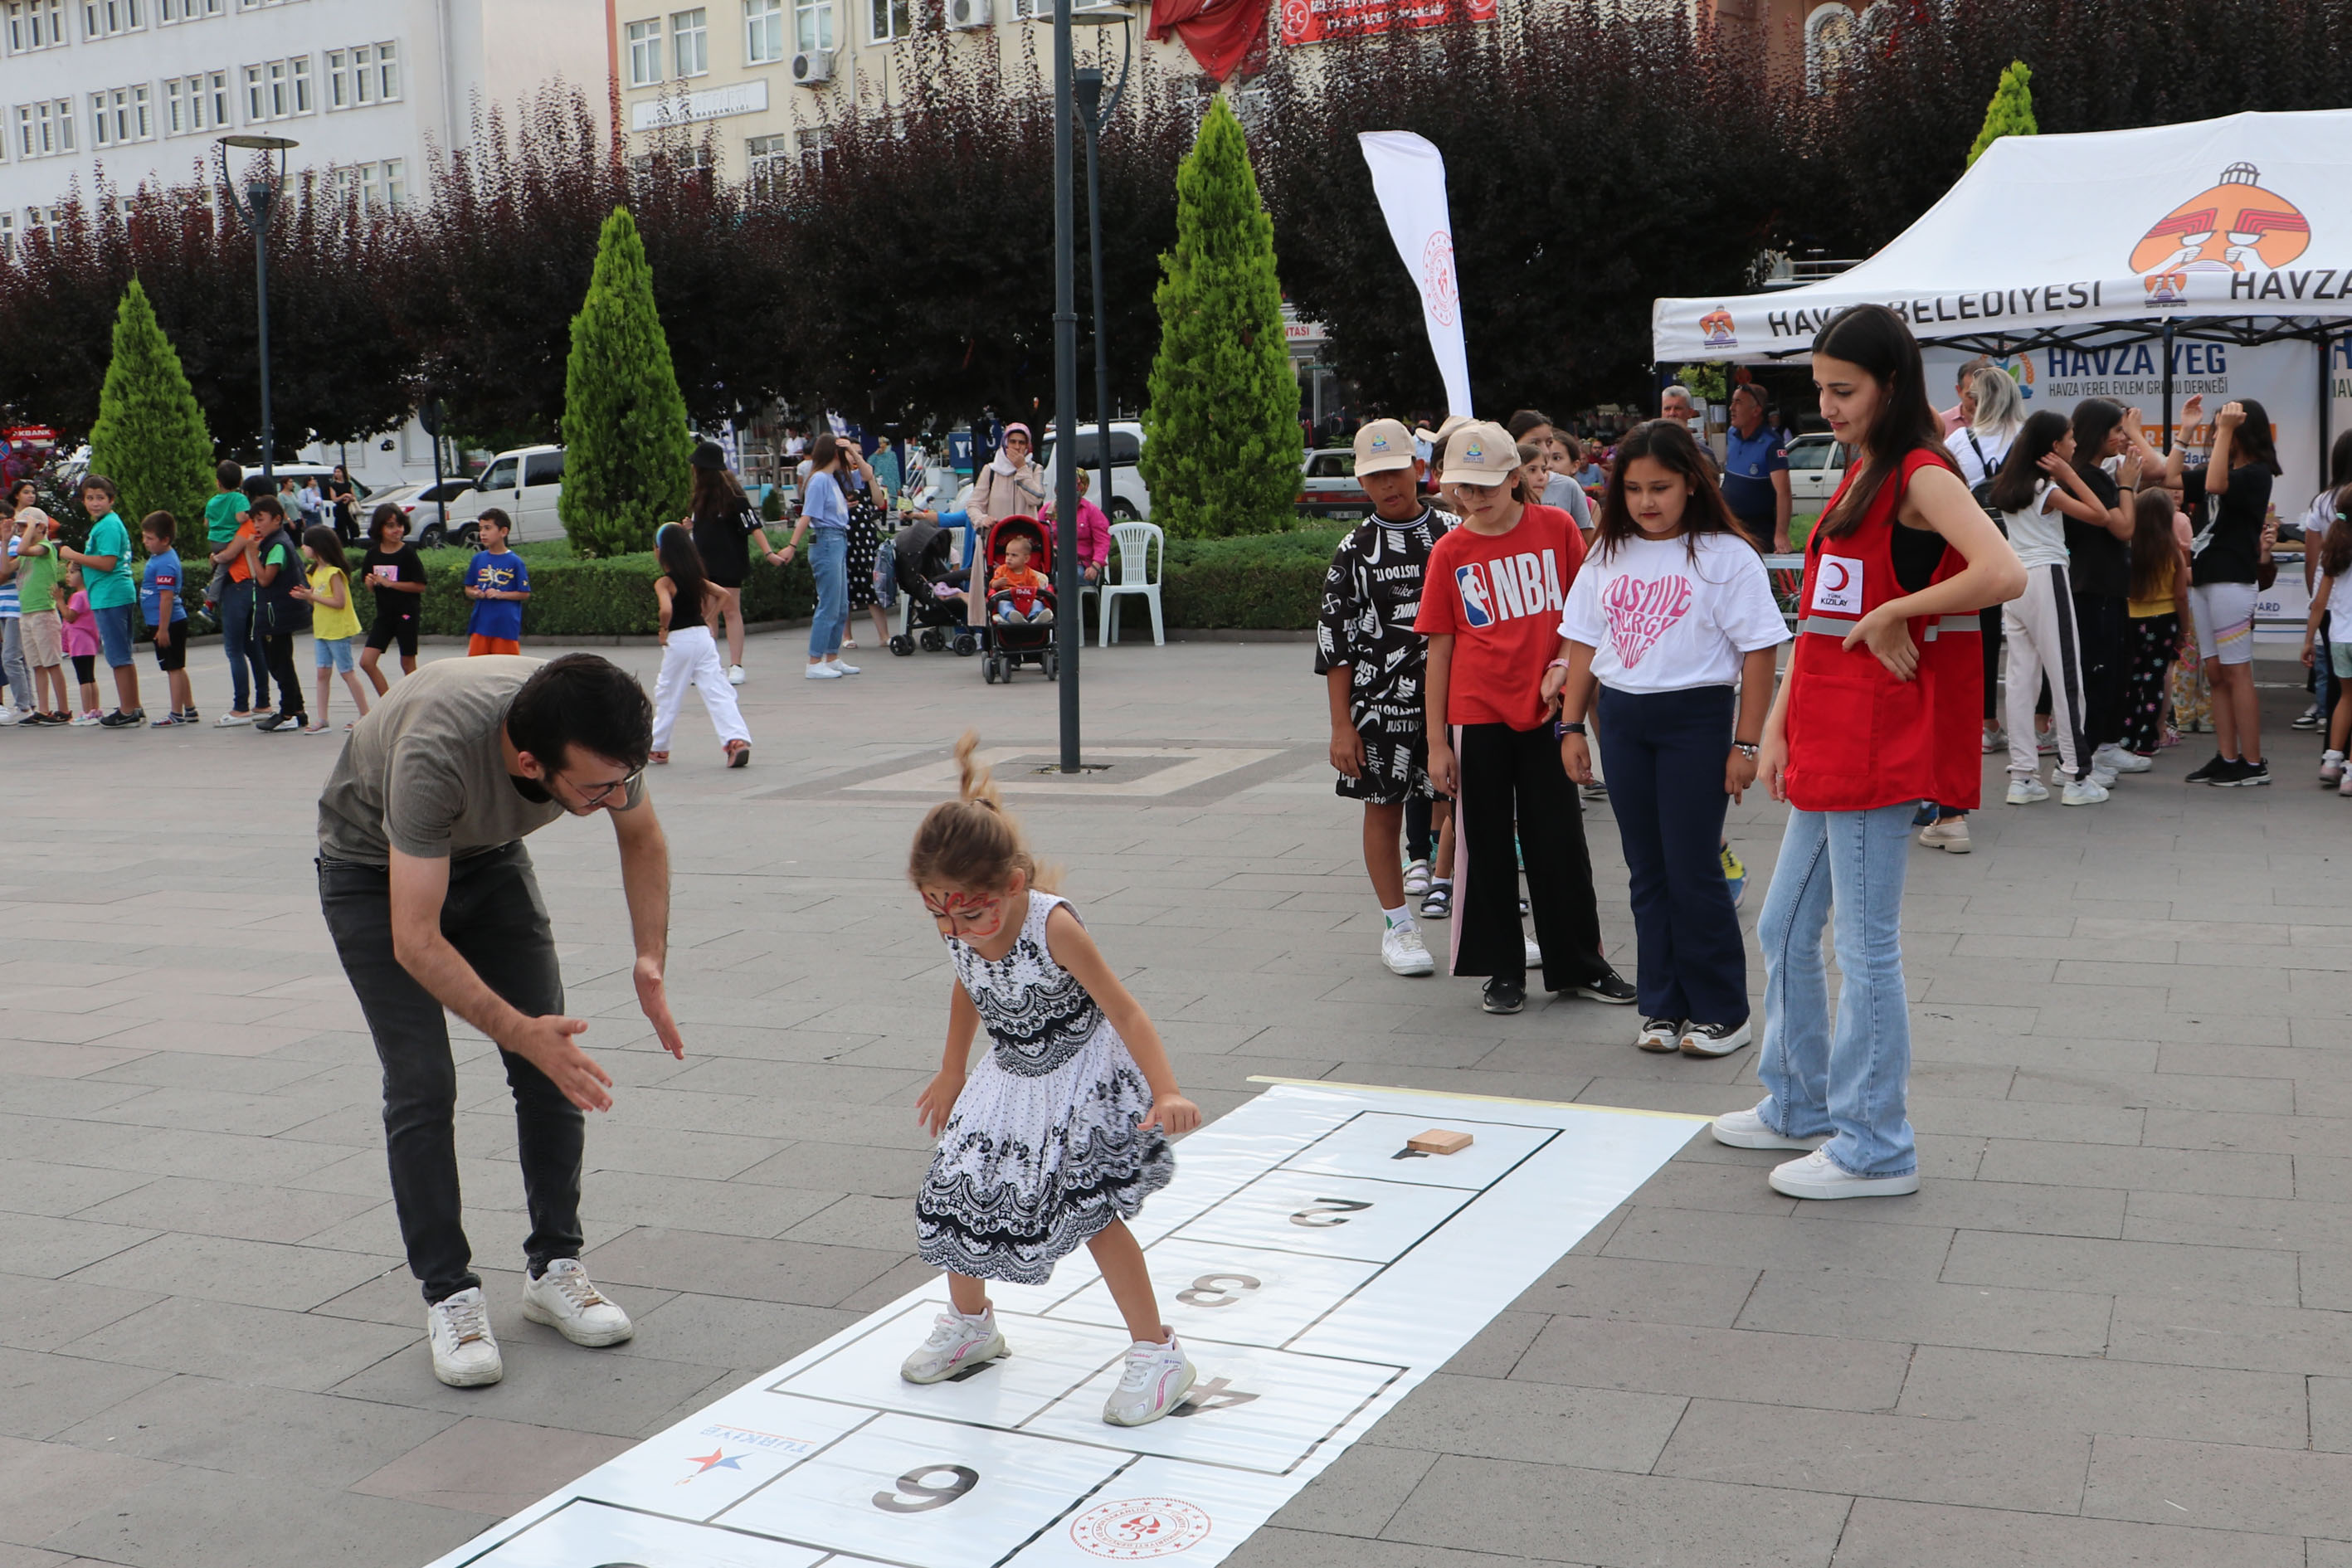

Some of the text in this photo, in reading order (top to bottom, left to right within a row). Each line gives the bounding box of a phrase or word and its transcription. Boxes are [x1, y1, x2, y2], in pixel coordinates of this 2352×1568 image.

[2048, 343, 2155, 377] HAVZA
[2049, 382, 2080, 397] HAVZA
[2081, 382, 2111, 396] YEREL
[2113, 381, 2144, 395] EYLEM
[1385, 566, 1400, 580] DO
[1399, 564, 1420, 580] JUST
[1488, 548, 1563, 621] NBA
[1391, 602, 1419, 621] NIKE
[1820, 597, 1848, 606] KIZILAY
[1321, 625, 1335, 653] NIKE
[1385, 645, 1406, 665] NIKE
[1355, 659, 1378, 679] JUST
[1385, 720, 1408, 733] JUST
[1366, 743, 1385, 775] nike
[1391, 743, 1411, 782] NIKE
[1289, 1197, 1375, 1228] 2
[1175, 1273, 1262, 1308] 3
